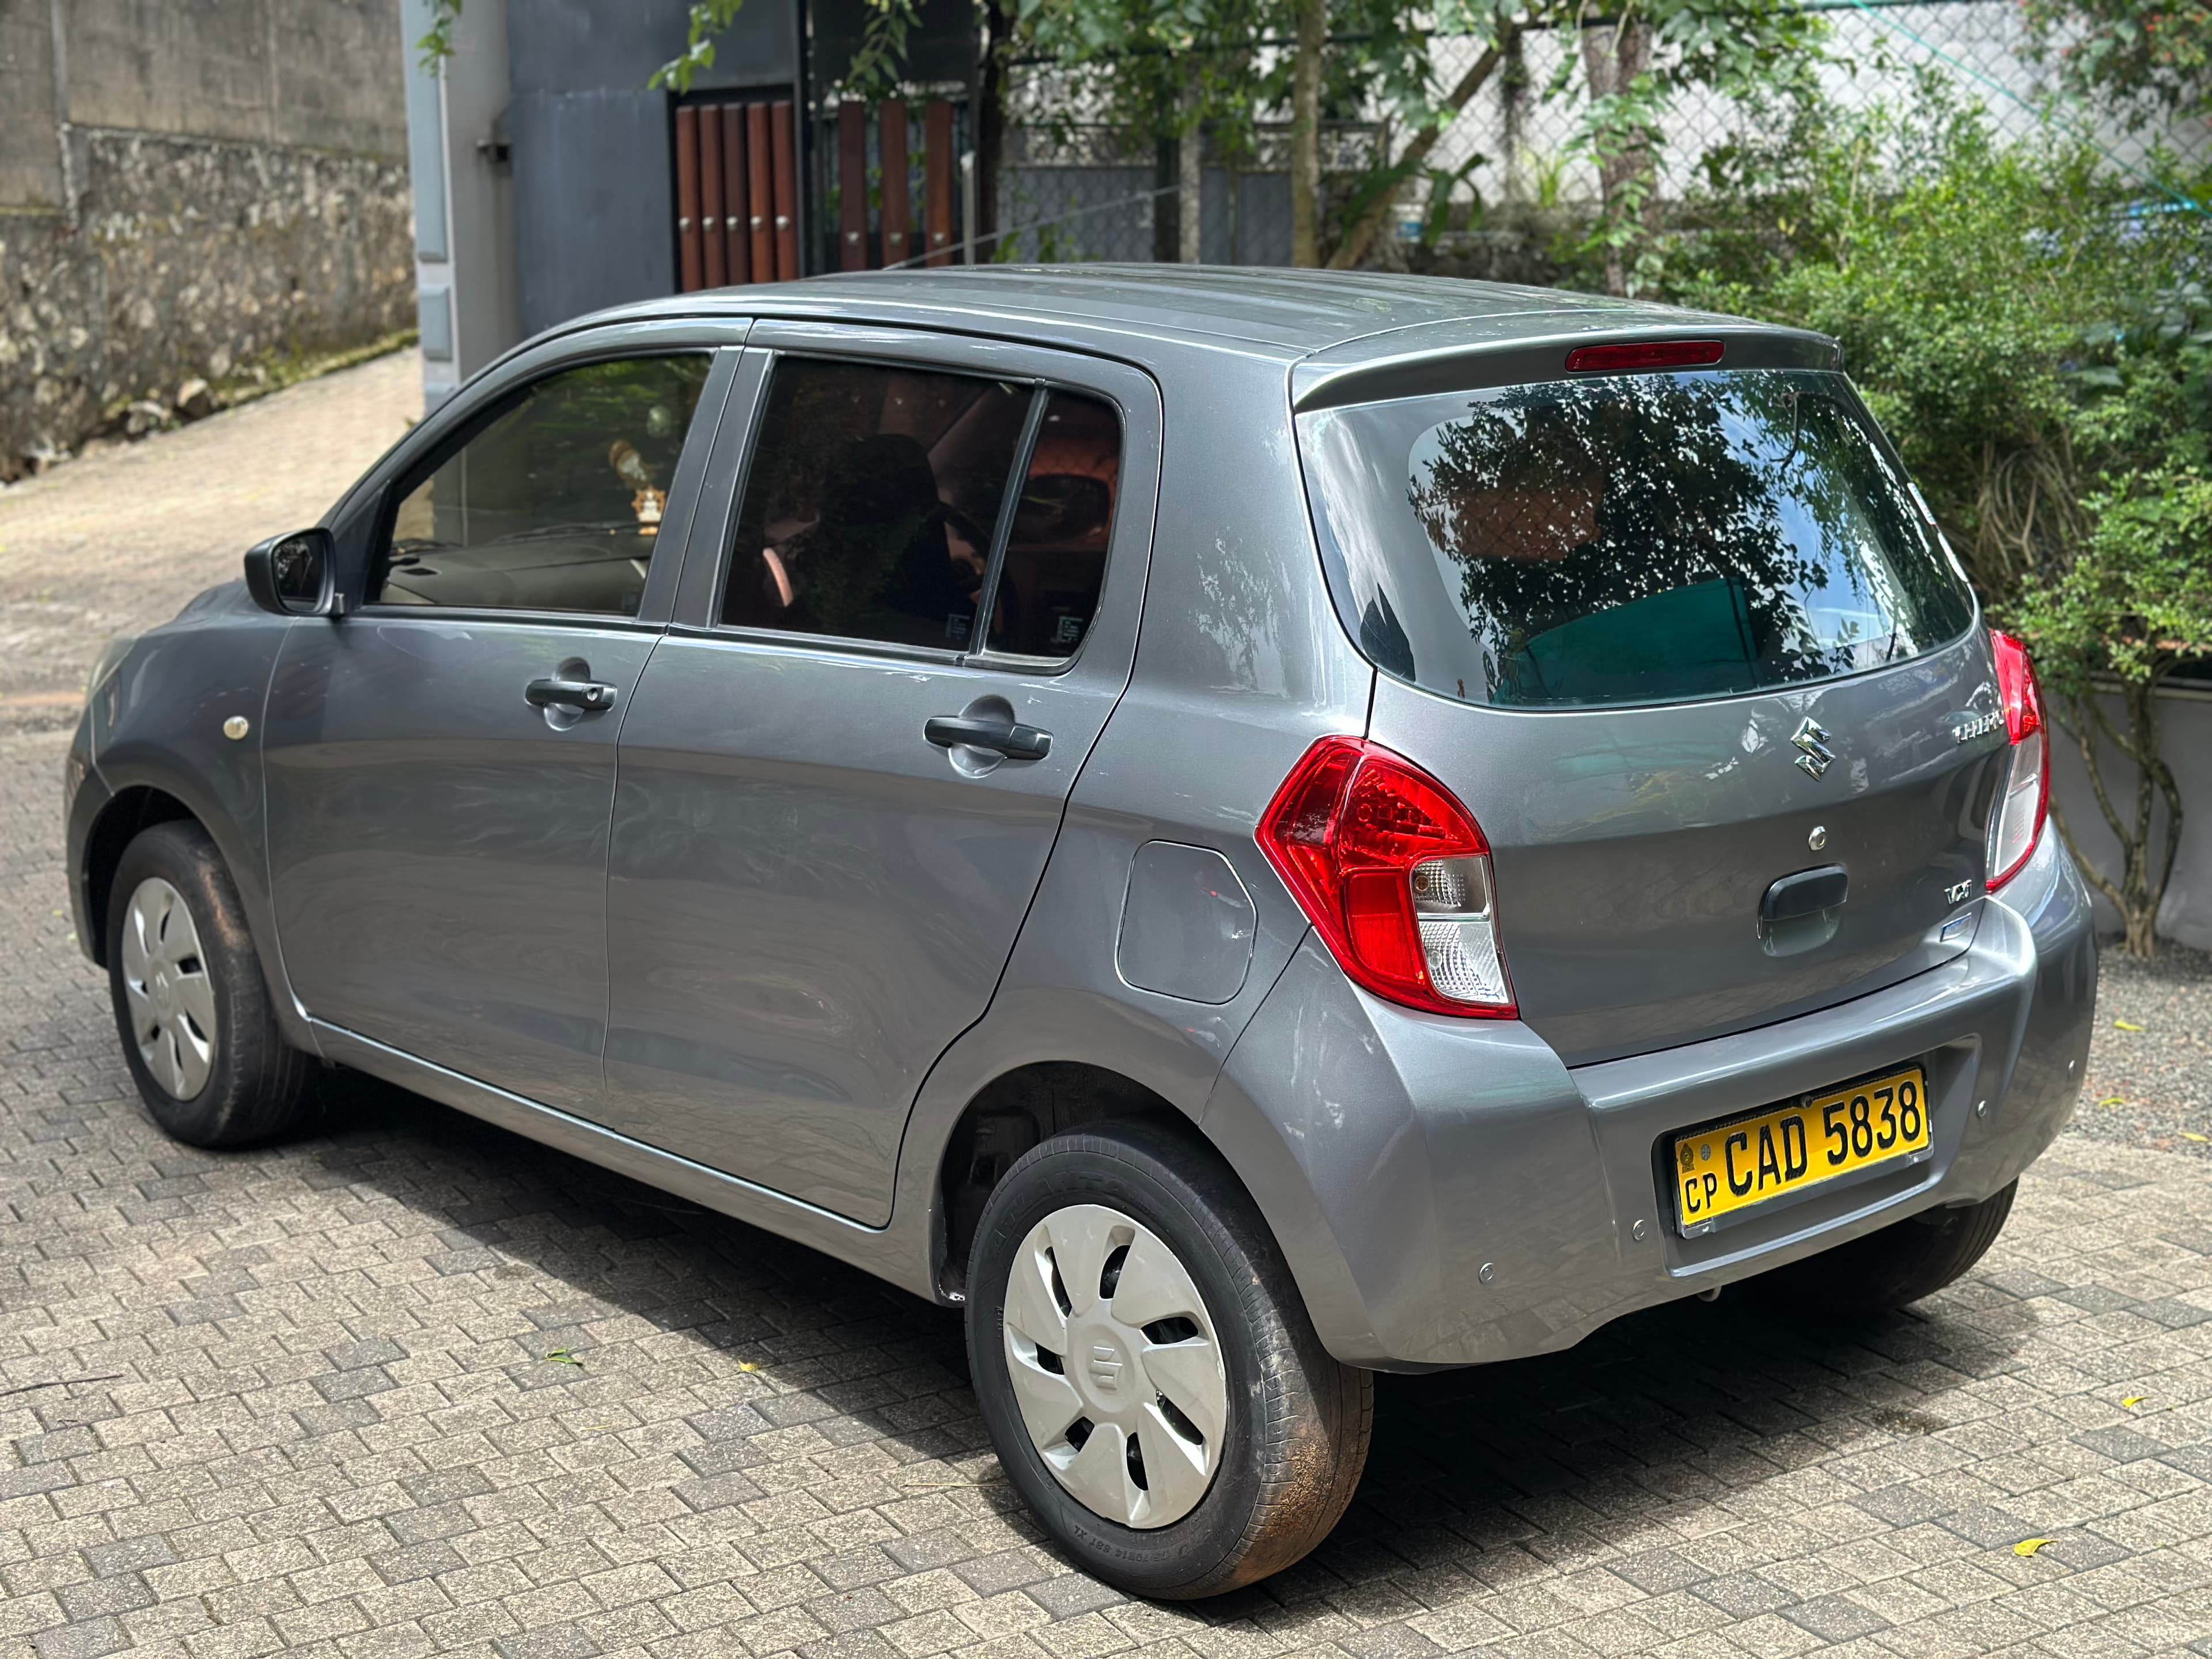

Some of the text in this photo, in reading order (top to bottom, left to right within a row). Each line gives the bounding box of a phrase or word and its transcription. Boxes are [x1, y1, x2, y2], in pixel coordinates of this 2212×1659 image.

[1684, 1080, 1921, 1213] CP CAD 5838
